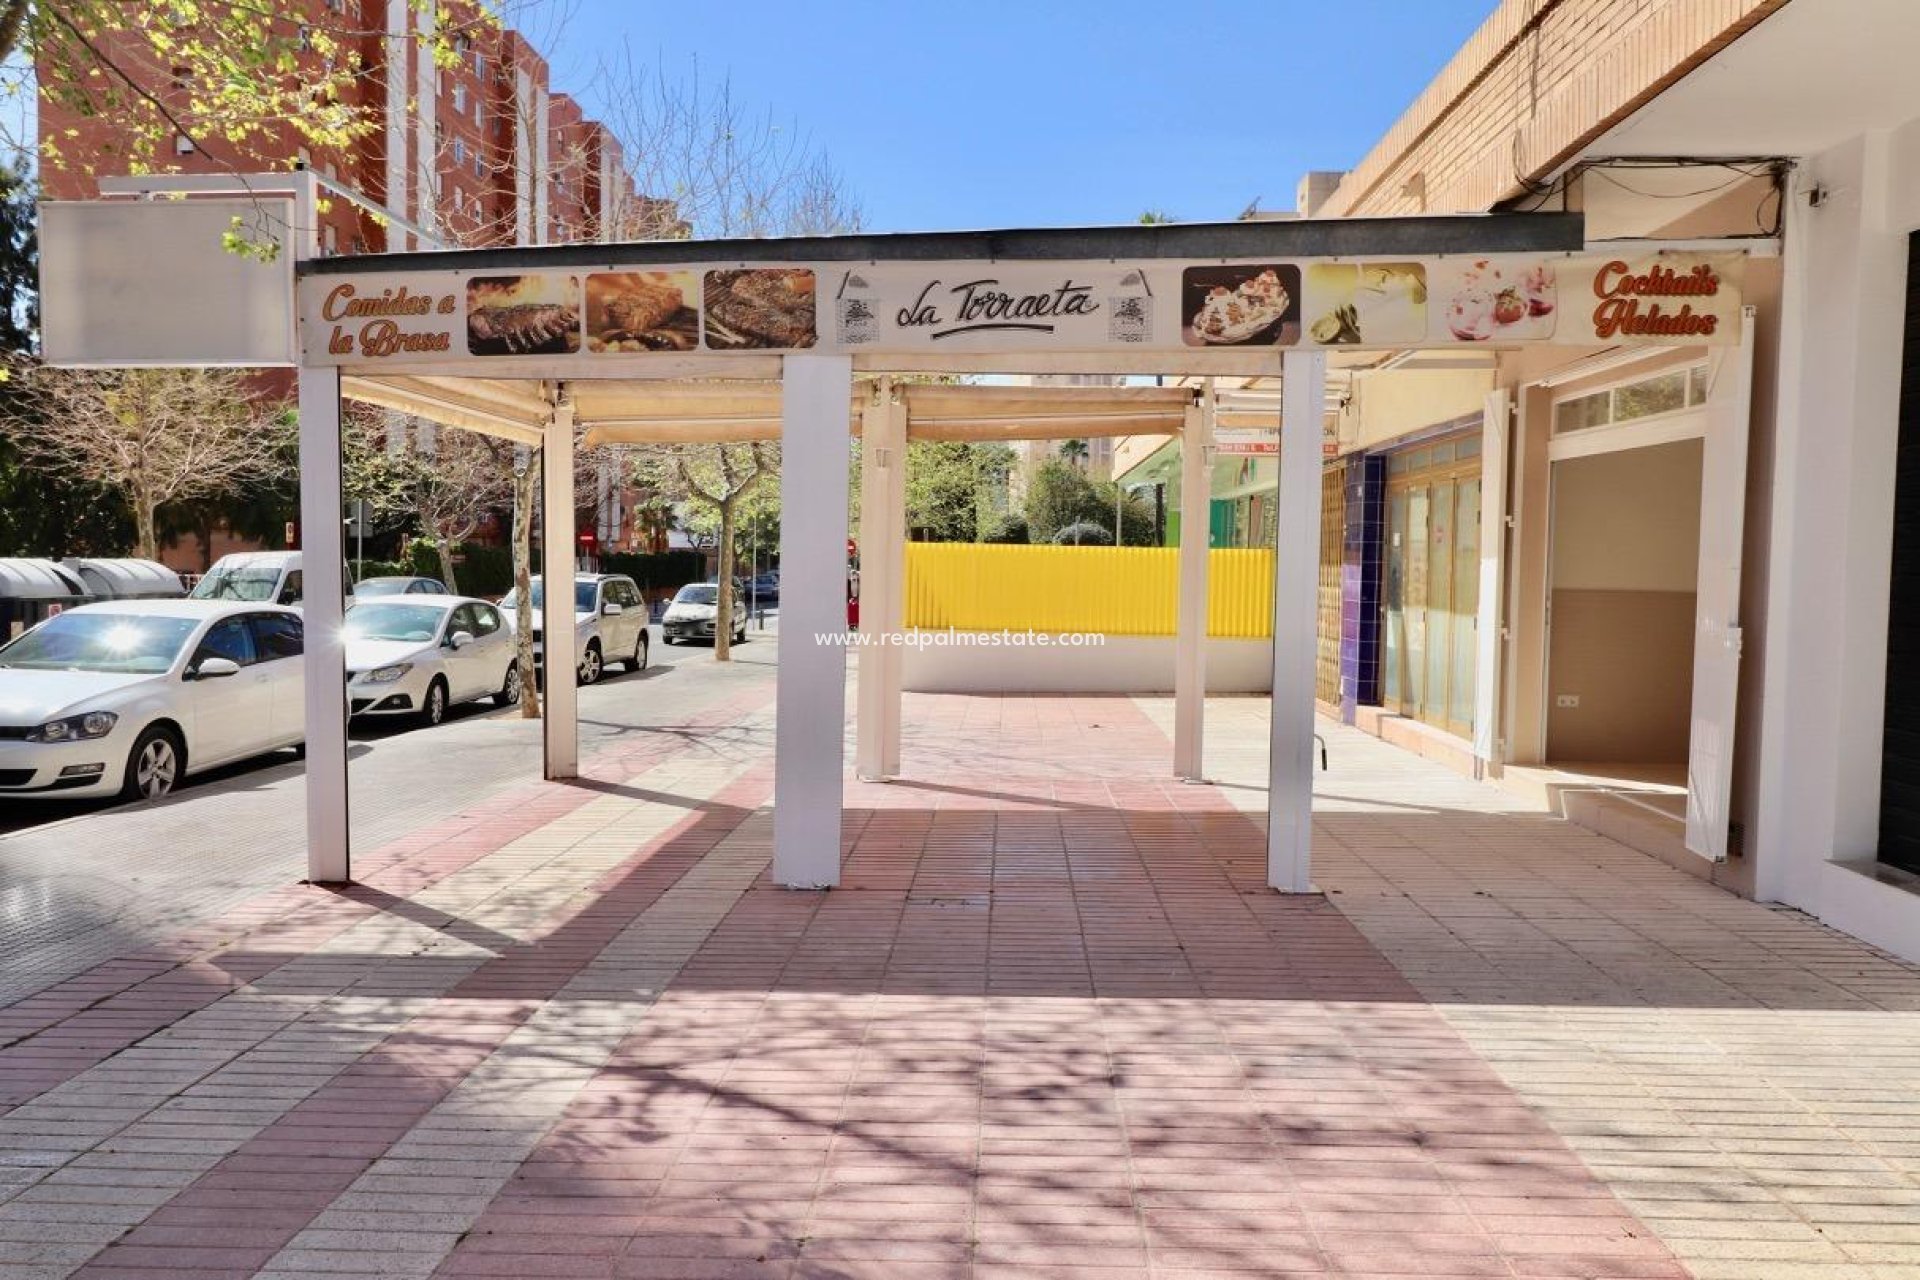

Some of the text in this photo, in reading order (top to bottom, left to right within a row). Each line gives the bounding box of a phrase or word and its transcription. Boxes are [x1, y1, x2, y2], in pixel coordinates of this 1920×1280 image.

[1593, 260, 1720, 299] Cocktails
[323, 283, 456, 321] Comidas a
[897, 279, 1100, 326] La Torraeta
[1592, 298, 1719, 339] Helados
[328, 319, 450, 357] la Brasa
